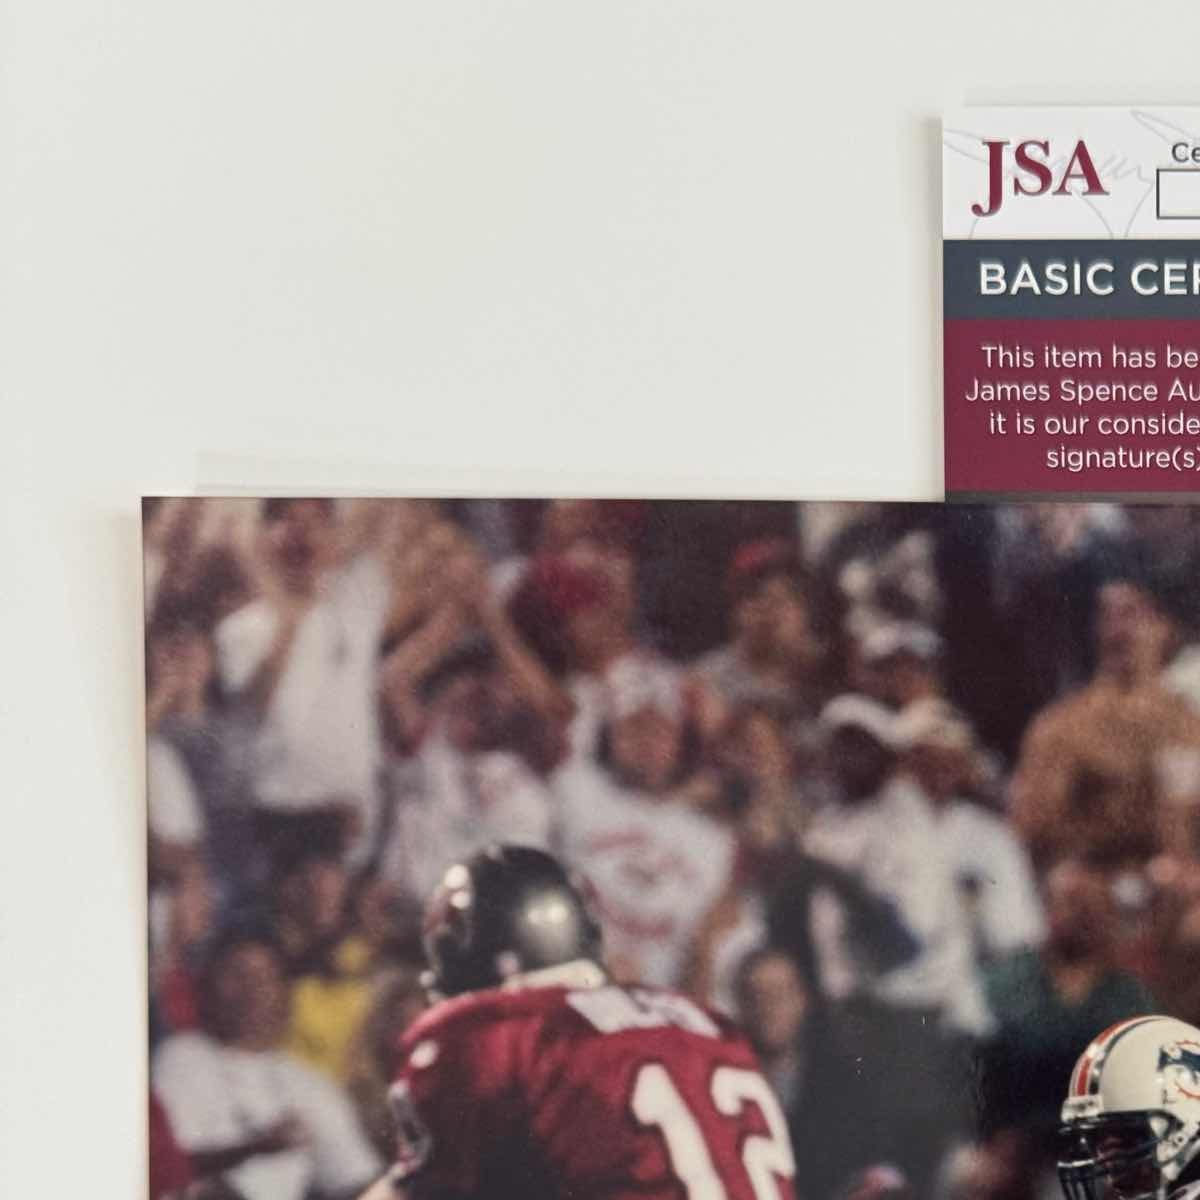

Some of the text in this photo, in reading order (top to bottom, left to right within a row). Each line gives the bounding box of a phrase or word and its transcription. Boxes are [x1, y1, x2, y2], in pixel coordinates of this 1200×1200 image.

[971, 139, 1110, 217] JSA
[979, 260, 1115, 296] BASIC
[980, 344, 1035, 369] This
[1044, 344, 1102, 369] item
[1112, 343, 1157, 369] has
[965, 377, 1051, 402] James
[1060, 378, 1159, 407] Spence
[990, 411, 1007, 435] it
[1016, 411, 1036, 435] is
[1044, 415, 1090, 435] our
